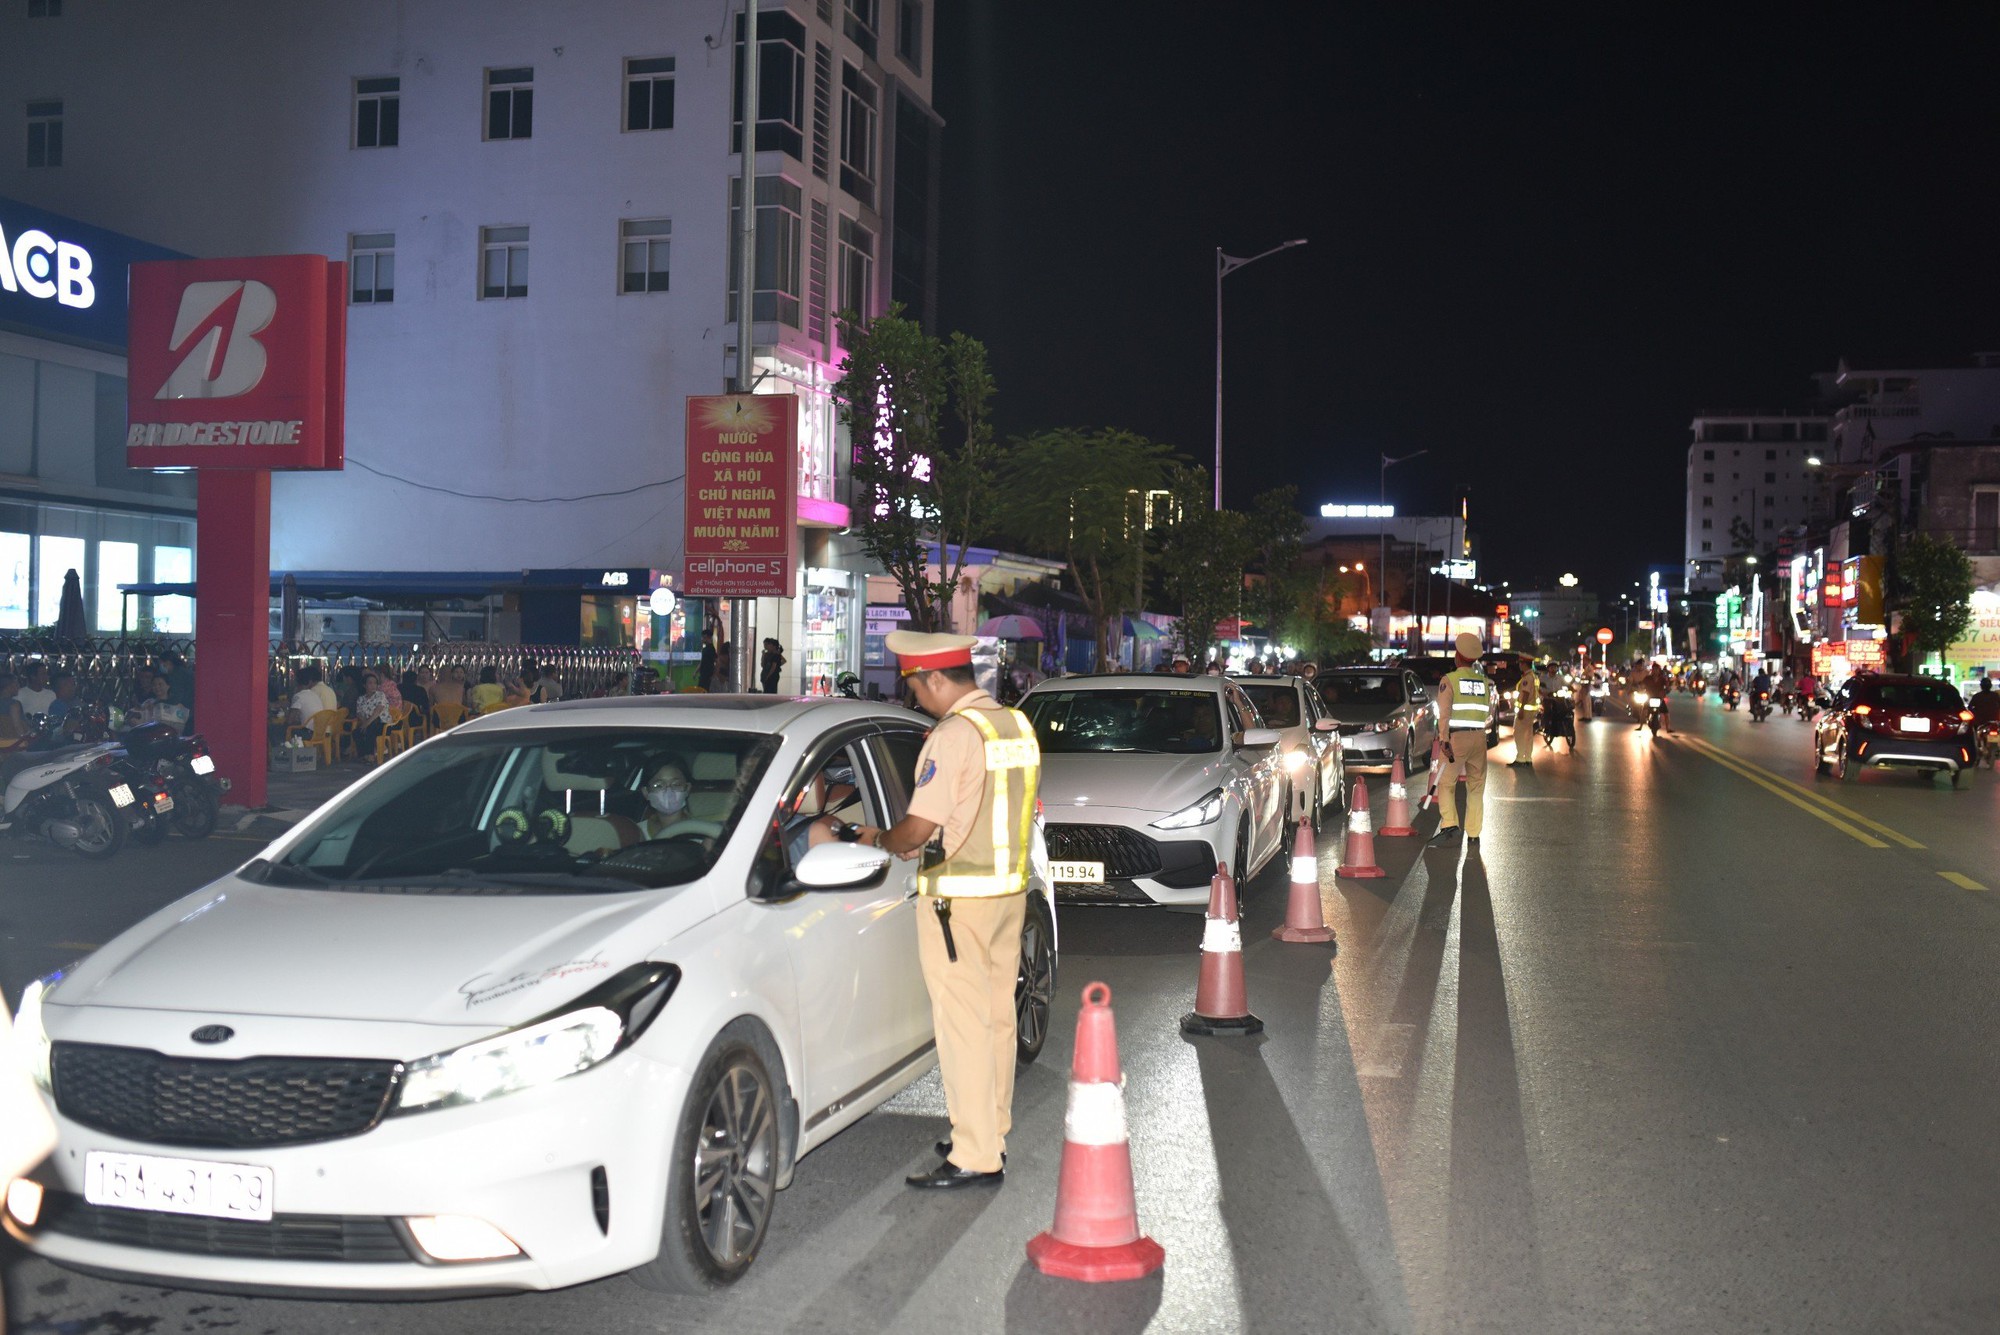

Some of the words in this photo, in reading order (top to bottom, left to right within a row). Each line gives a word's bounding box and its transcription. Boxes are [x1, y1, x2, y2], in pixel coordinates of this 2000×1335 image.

[127, 420, 303, 447] BRIDGESTONE
[718, 431, 758, 445] NƯỚC
[701, 449, 741, 466] CỘNG
[745, 449, 774, 463] HÒA
[713, 467, 733, 482] XÃ
[737, 467, 762, 485] HỘI
[698, 486, 728, 501] CHỦ
[731, 486, 776, 501] NGHĨA
[703, 505, 734, 522] VIỆT
[737, 507, 771, 519] NAM
[693, 524, 737, 538] MUÔN
[740, 524, 780, 538] NĂM!
